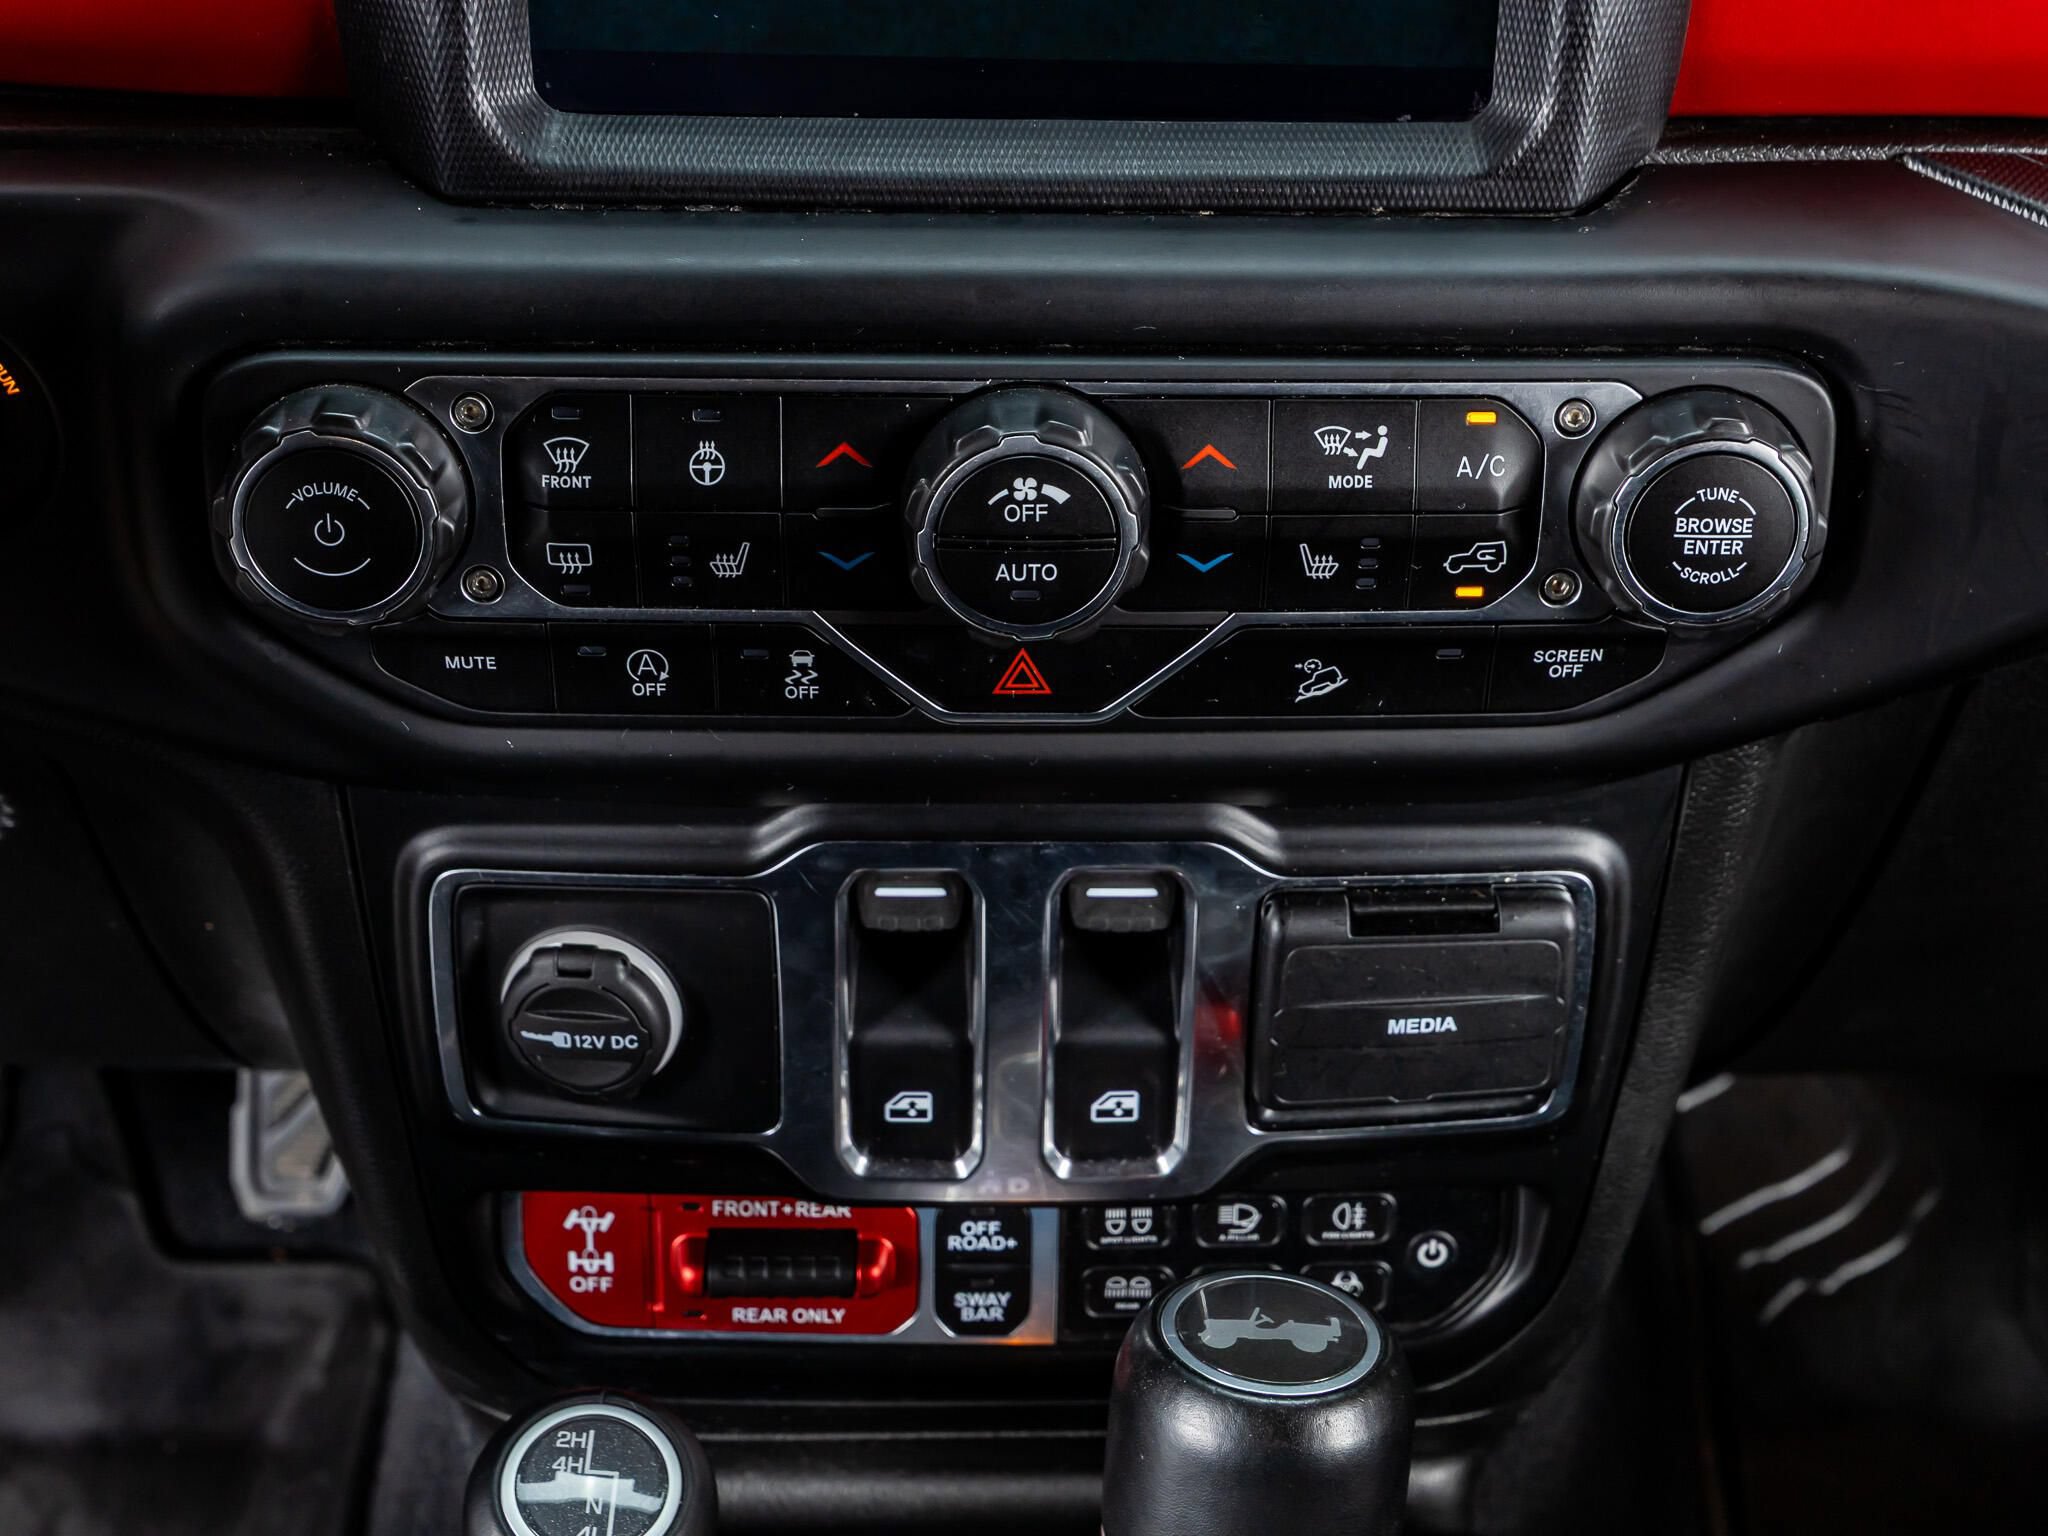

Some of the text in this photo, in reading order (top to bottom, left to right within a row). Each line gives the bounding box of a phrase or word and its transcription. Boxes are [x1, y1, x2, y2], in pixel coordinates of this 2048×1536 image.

[1457, 453, 1505, 479] A/C
[542, 475, 591, 488] FRONT
[1329, 475, 1372, 488] MODE
[292, 482, 359, 502] VOLUME
[1697, 488, 1740, 503] TUNE
[1005, 504, 1048, 522] OFF
[1676, 518, 1753, 533] BROWSE
[1684, 540, 1743, 554] ENTER
[996, 564, 1057, 581] AUTO
[1680, 567, 1740, 584] SCROLL
[445, 656, 496, 669] MUTE
[1534, 649, 1603, 662] SCREEN
[1549, 664, 1583, 677] OFF
[632, 683, 666, 696] OFF
[785, 686, 819, 698] OFF
[1388, 1017, 1457, 1034] MEDIA
[574, 1035, 638, 1049] 12V DC
[961, 1221, 1001, 1235] OFF
[948, 1234, 1017, 1250] ROAD+
[570, 1276, 612, 1292] OFF
[955, 1293, 1010, 1308] SWAY
[732, 1308, 845, 1323] REAR ONLY
[960, 1306, 1004, 1322] BAR
[556, 1431, 586, 1448] 2H
[552, 1456, 584, 1474] 4H
[585, 1497, 602, 1514] N
